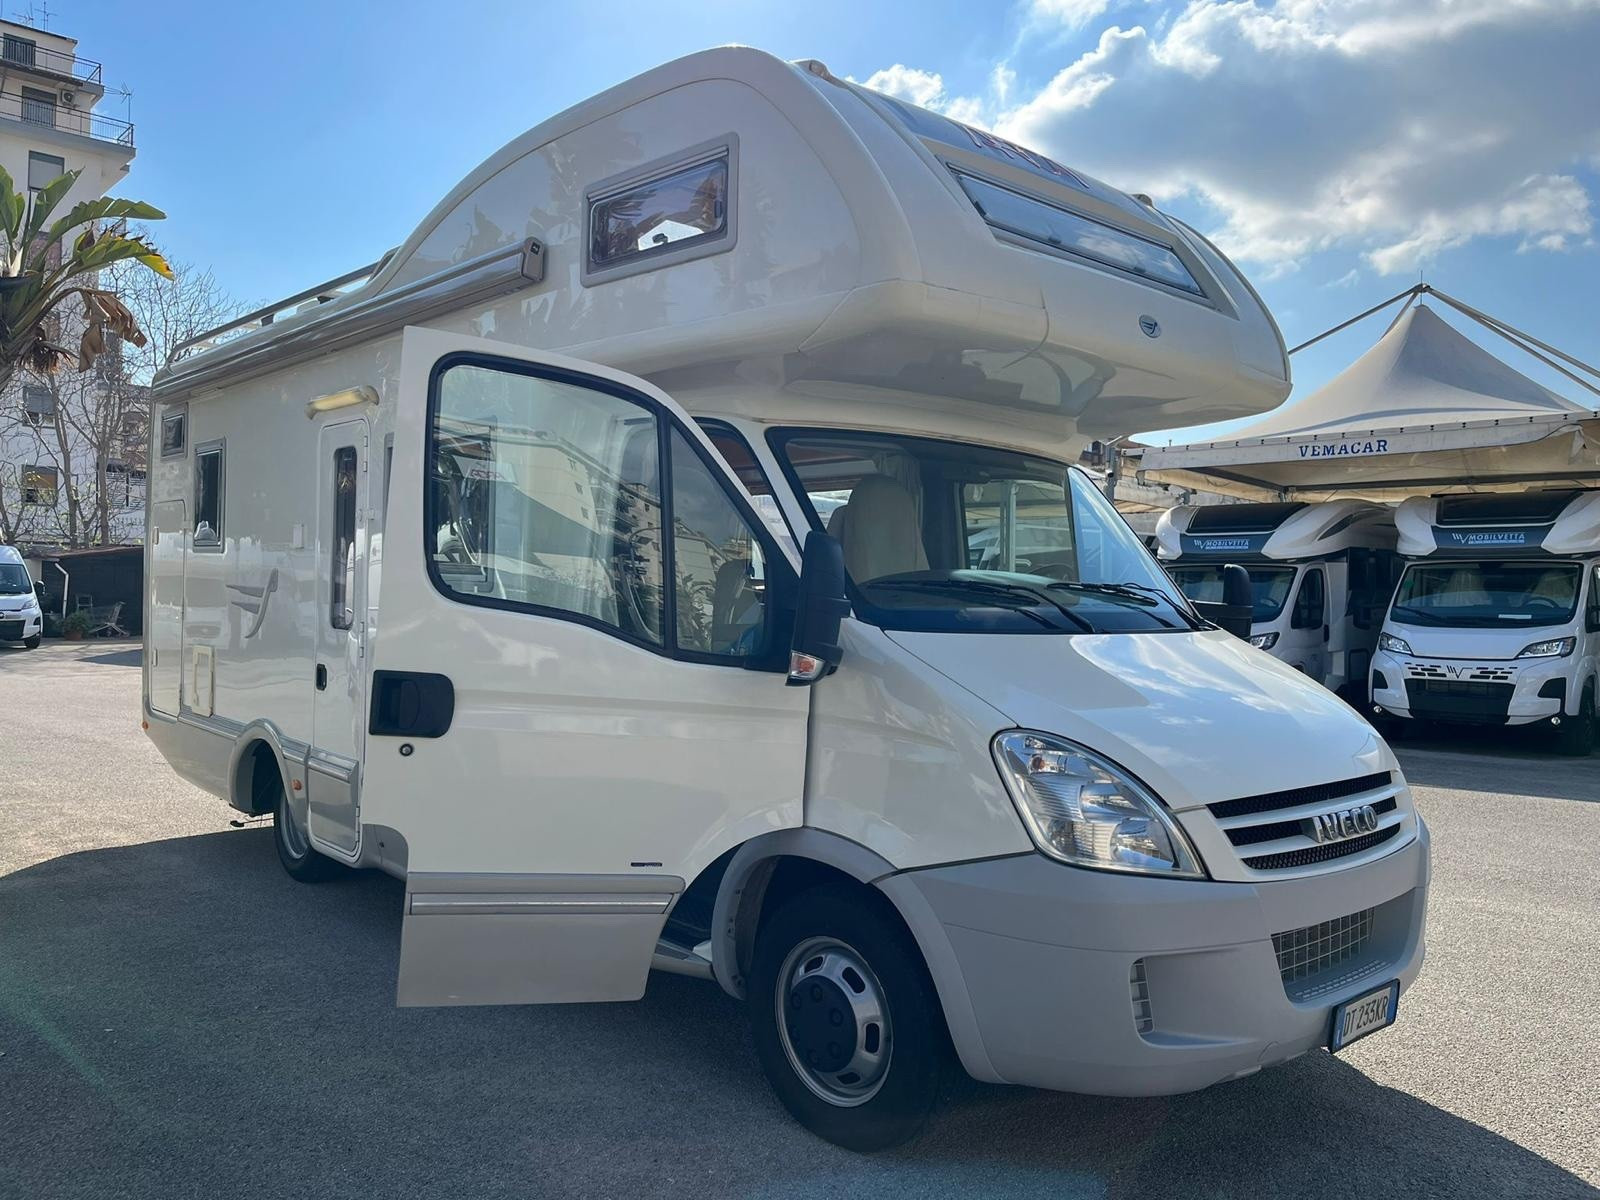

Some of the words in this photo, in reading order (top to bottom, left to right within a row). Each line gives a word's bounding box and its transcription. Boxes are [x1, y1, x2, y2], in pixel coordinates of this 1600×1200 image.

[1299, 440, 1388, 457] VEMACAR
[1312, 805, 1378, 843] IVECO
[1343, 1008, 1357, 1037] DT
